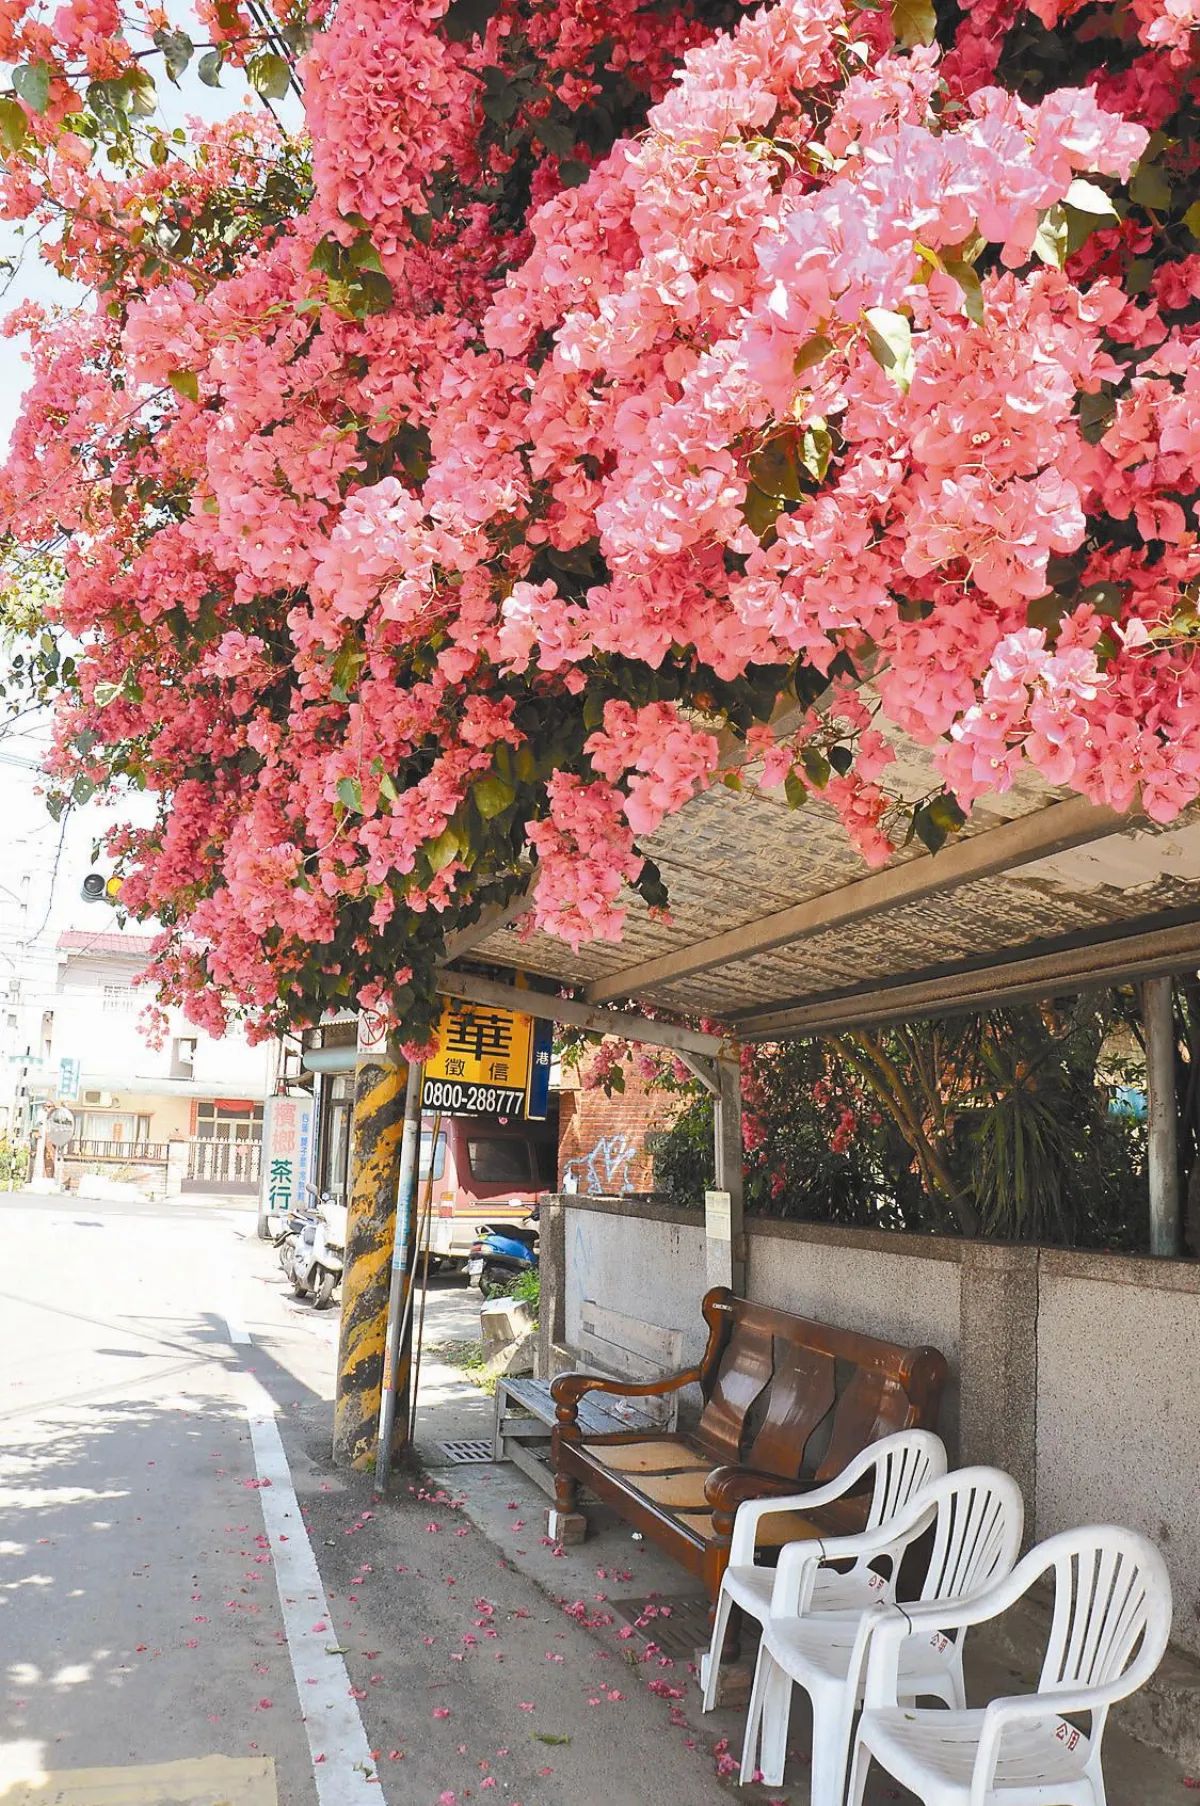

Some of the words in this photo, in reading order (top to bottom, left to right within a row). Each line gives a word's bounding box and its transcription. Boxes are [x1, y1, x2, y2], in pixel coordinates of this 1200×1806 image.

[445, 1058, 509, 1082] 徵信
[423, 1081, 525, 1115] 0800-288777
[1055, 1722, 1081, 1752] 公用
